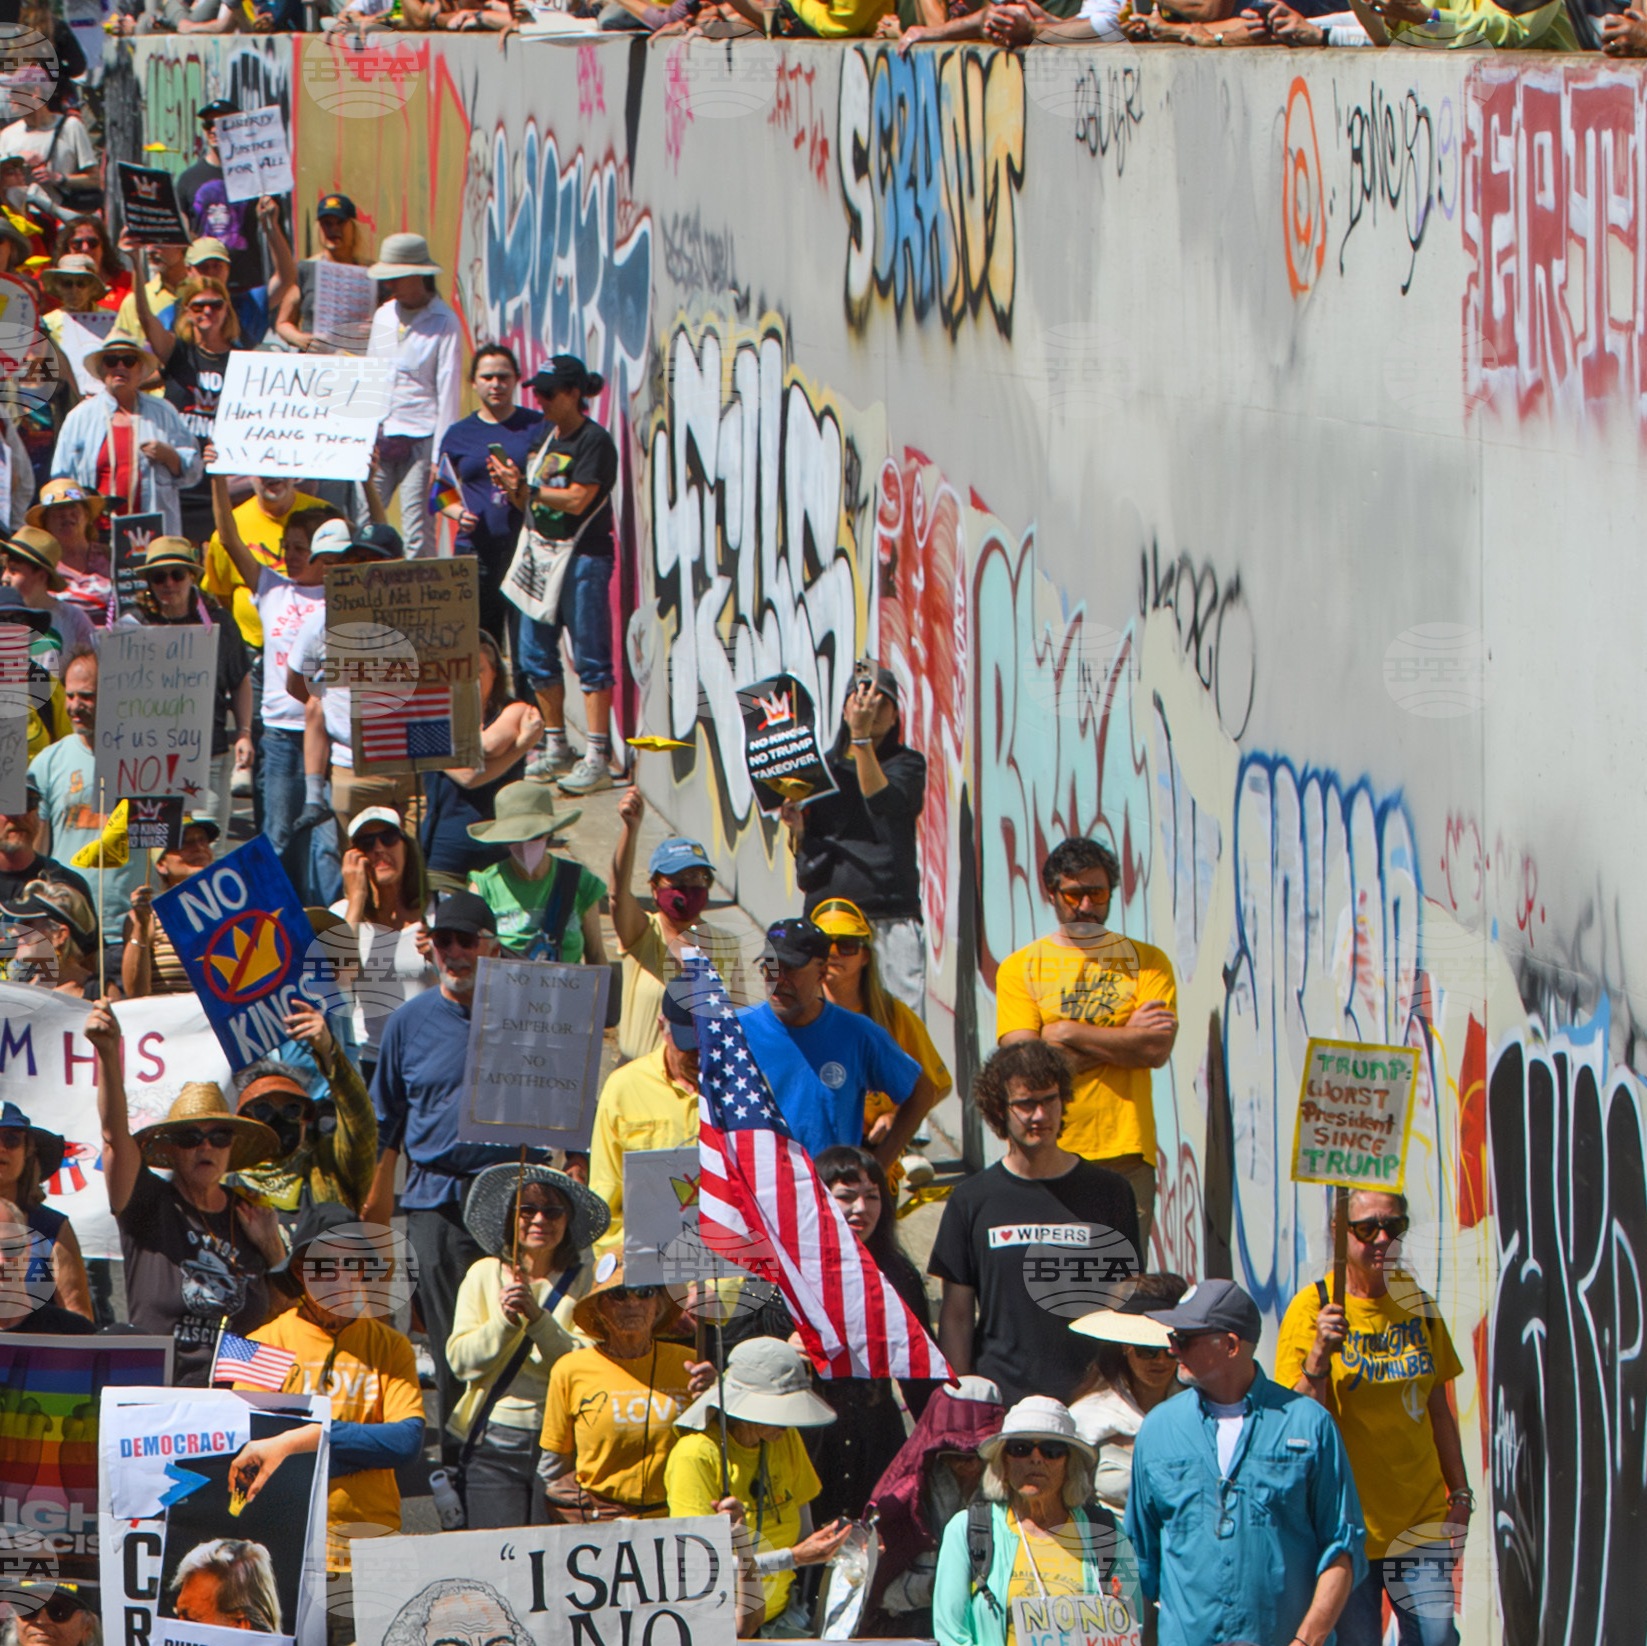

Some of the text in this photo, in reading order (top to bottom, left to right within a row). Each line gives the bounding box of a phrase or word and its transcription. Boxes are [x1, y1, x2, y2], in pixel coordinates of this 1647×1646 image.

[243, 365, 333, 398] HANG
[270, 403, 328, 420] HIGH
[106, 630, 194, 660] This all
[161, 666, 209, 689] when
[104, 727, 202, 762] of us say
[749, 737, 813, 767] NO TRUMP
[117, 753, 180, 794] NO!
[751, 753, 819, 779] TAKEOVER.
[177, 867, 248, 933] NO
[228, 972, 327, 1065] KINGS
[502, 1019, 573, 1034] EMPEROR
[486, 1072, 578, 1090] APOTHEOSIS
[1307, 1079, 1390, 1110] WORST
[1301, 1101, 1394, 1135] President
[1314, 1127, 1386, 1158] SINCE
[1303, 1149, 1400, 1178] TRUMP
[1016, 1224, 1091, 1245] WIPERS
[120, 1431, 236, 1458] DEMOCRACY
[564, 1535, 728, 1608] SAID,
